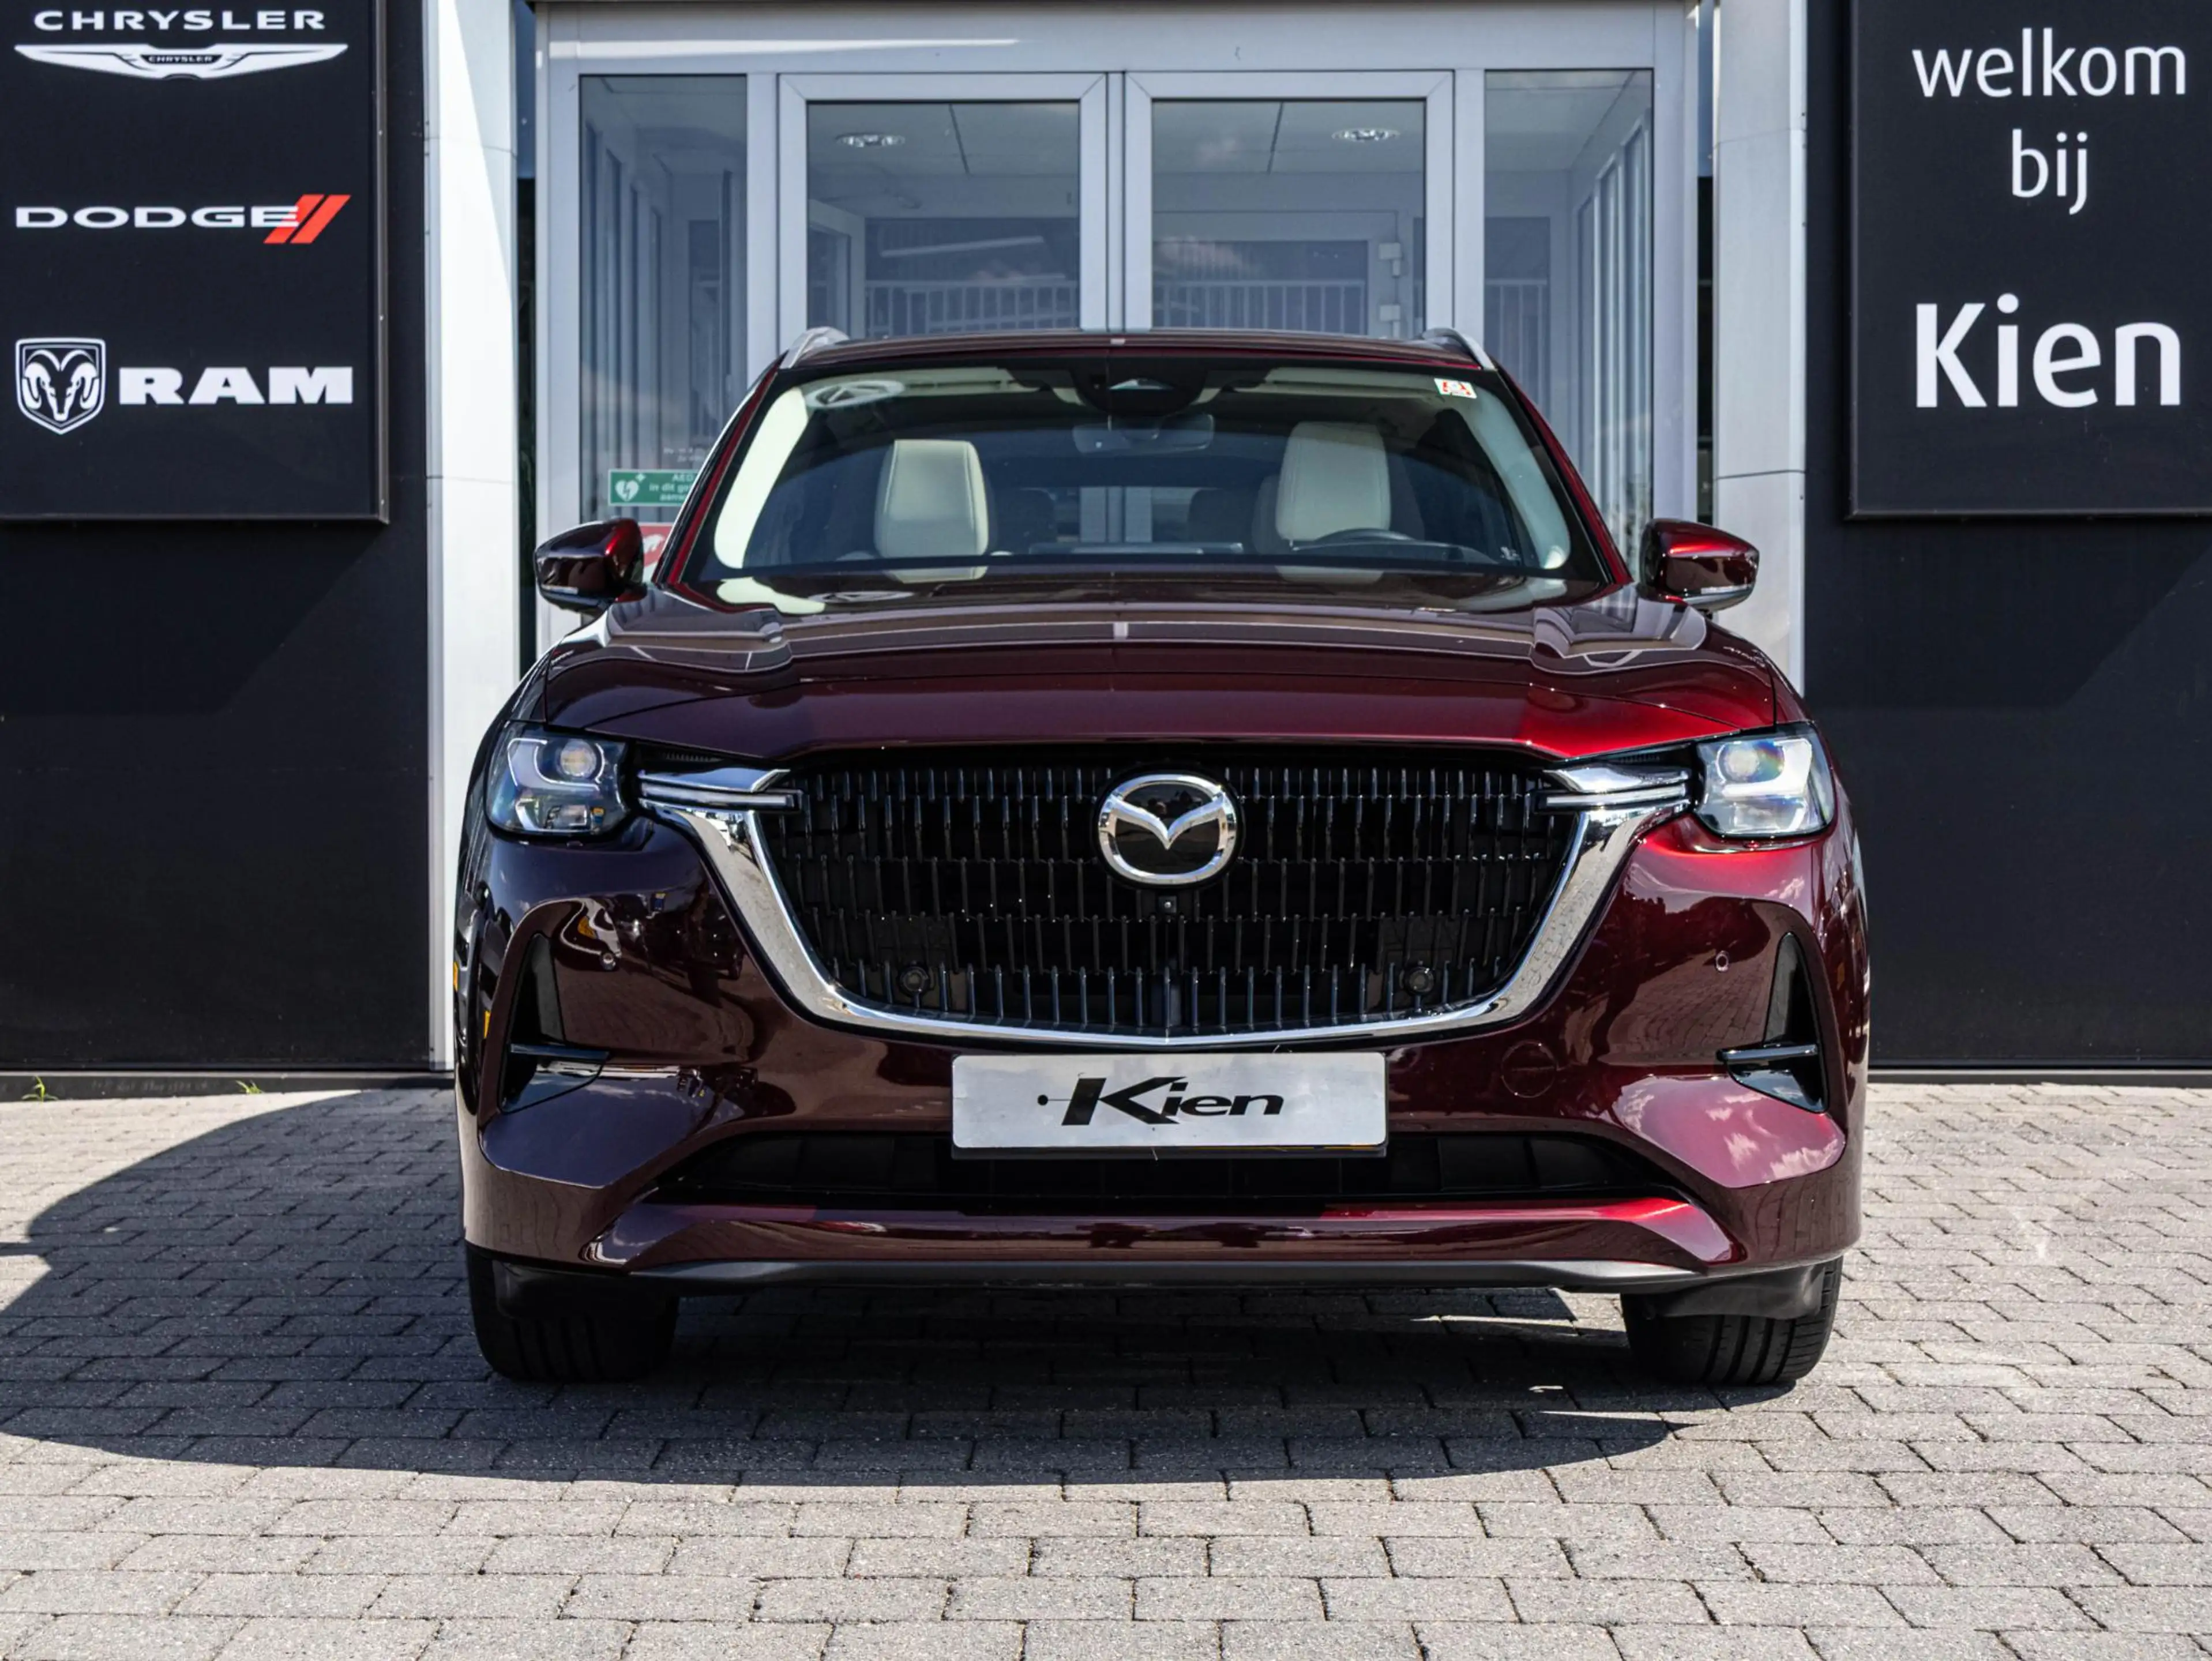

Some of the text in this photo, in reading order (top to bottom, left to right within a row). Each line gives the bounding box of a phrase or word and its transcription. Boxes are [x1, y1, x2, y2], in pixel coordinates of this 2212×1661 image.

[35, 10, 325, 31] CHRYSLER
[1912, 28, 2186, 97] welkom
[2012, 129, 2088, 215] bij
[16, 206, 299, 228] DODGE
[1916, 293, 2181, 408] Kien
[119, 367, 353, 405] RAM
[1061, 1076, 1284, 1126] Kien
